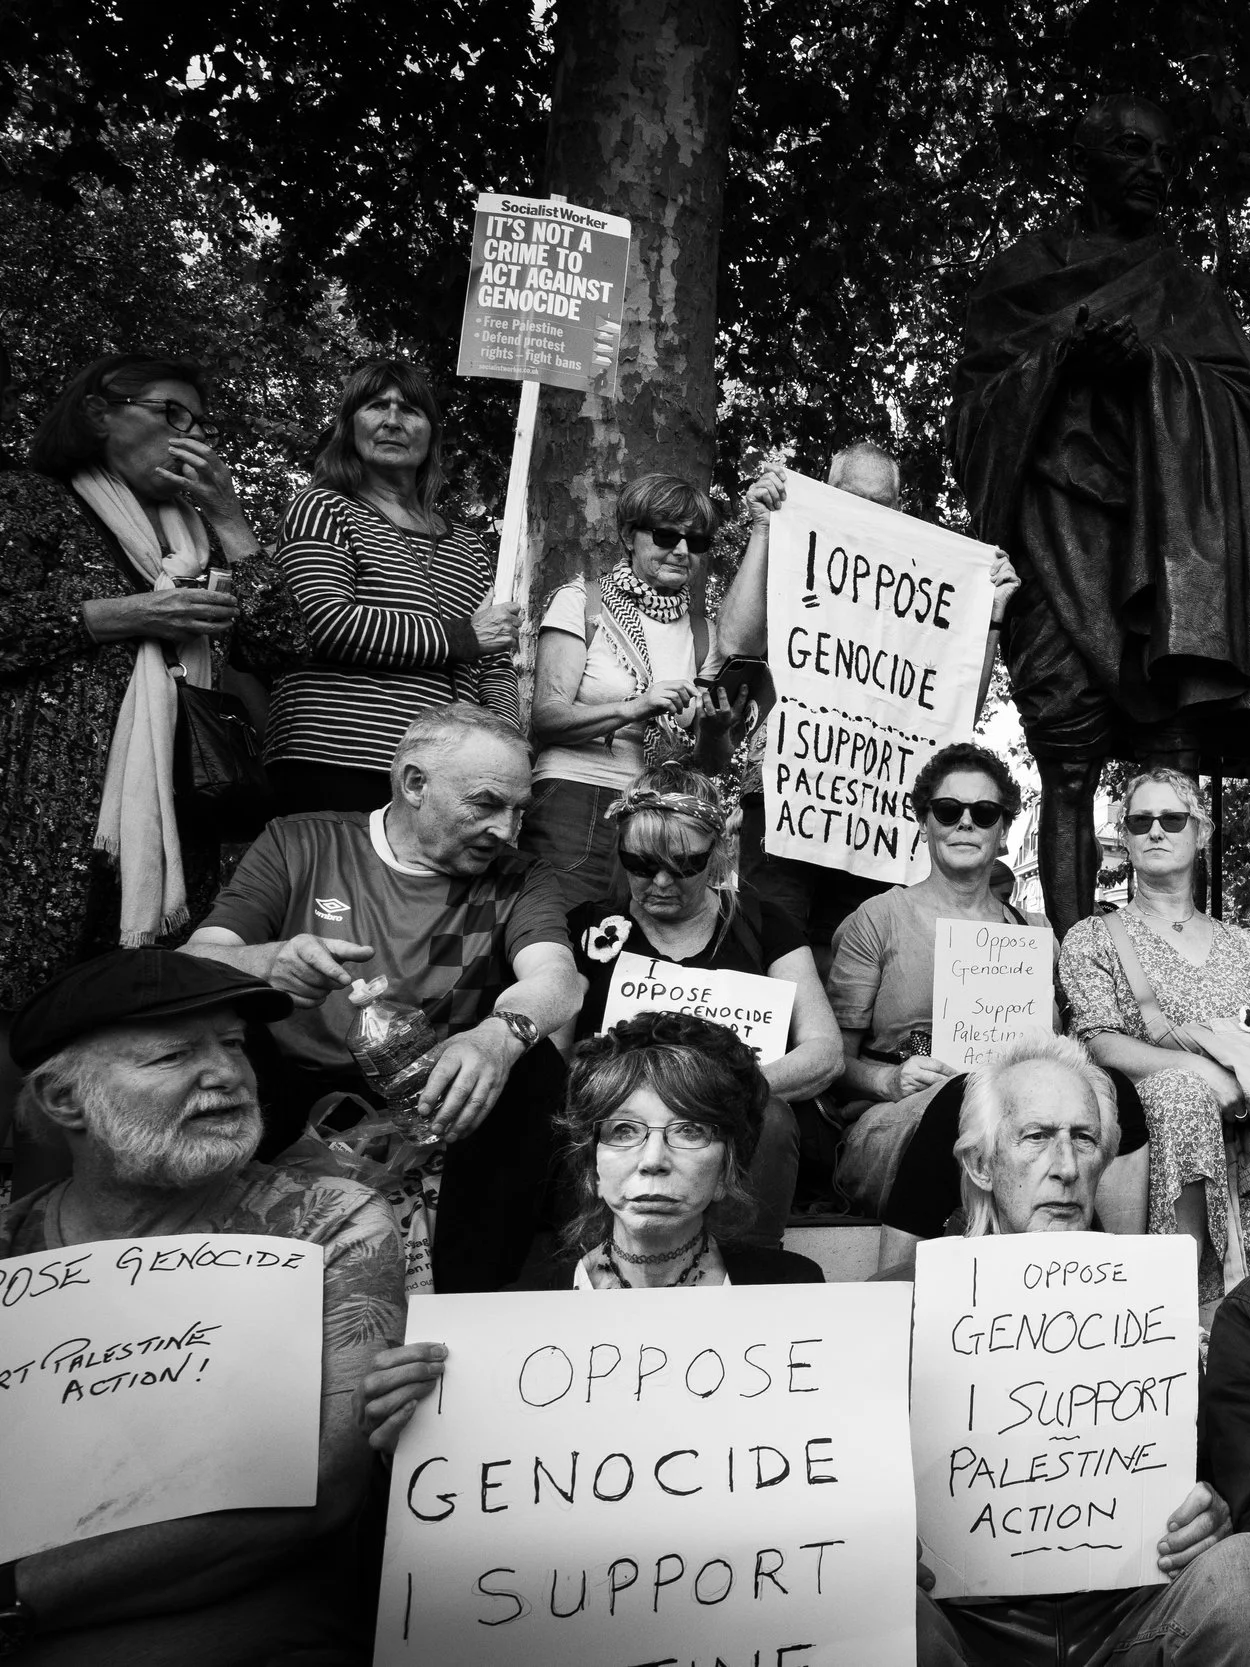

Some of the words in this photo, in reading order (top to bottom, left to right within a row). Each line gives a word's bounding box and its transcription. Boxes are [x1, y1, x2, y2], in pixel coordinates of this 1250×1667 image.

[501, 200, 559, 218] Socialist
[559, 207, 608, 230] Worker
[484, 238, 550, 266] CRIME
[556, 247, 582, 273] TO
[532, 221, 574, 248] NOT
[578, 231, 592, 253] A
[479, 261, 521, 287] ACT
[525, 267, 614, 303] AGAINST
[478, 285, 582, 321] GENOCIDE
[481, 331, 521, 346] Defend
[524, 334, 566, 353] protest
[483, 315, 509, 330] Free
[512, 319, 564, 338] Palestine
[480, 346, 514, 360] rights
[525, 349, 552, 366] fight
[555, 354, 582, 371] bans
[827, 546, 955, 630] OPPOSE
[787, 626, 937, 711] GENOCIDE
[777, 711, 786, 755] I
[794, 719, 914, 785] SUPPORT
[776, 763, 916, 824] PALESTINE
[315, 909, 343, 922] umbro
[975, 927, 1038, 962] Oppose
[644, 959, 660, 980] I
[951, 959, 1034, 986] Genocide
[620, 981, 713, 1003] OPPOSE
[972, 997, 1036, 1023] Support
[116, 1241, 305, 1286] GENOCIDE
[1023, 1260, 1128, 1290] OPPOSE
[40, 1320, 223, 1375] PALESTINE
[951, 1304, 1176, 1356] GENOCIDE
[519, 1338, 823, 1408] OPPOSE
[968, 1383, 975, 1432] I
[997, 1372, 1188, 1436] SUPPORT
[406, 1437, 839, 1522] GENOCIDE
[949, 1442, 1168, 1498] PALESTINE
[969, 1497, 1117, 1539] ACTION
[402, 1571, 413, 1645] I
[473, 1540, 846, 1627] SUPPORT
